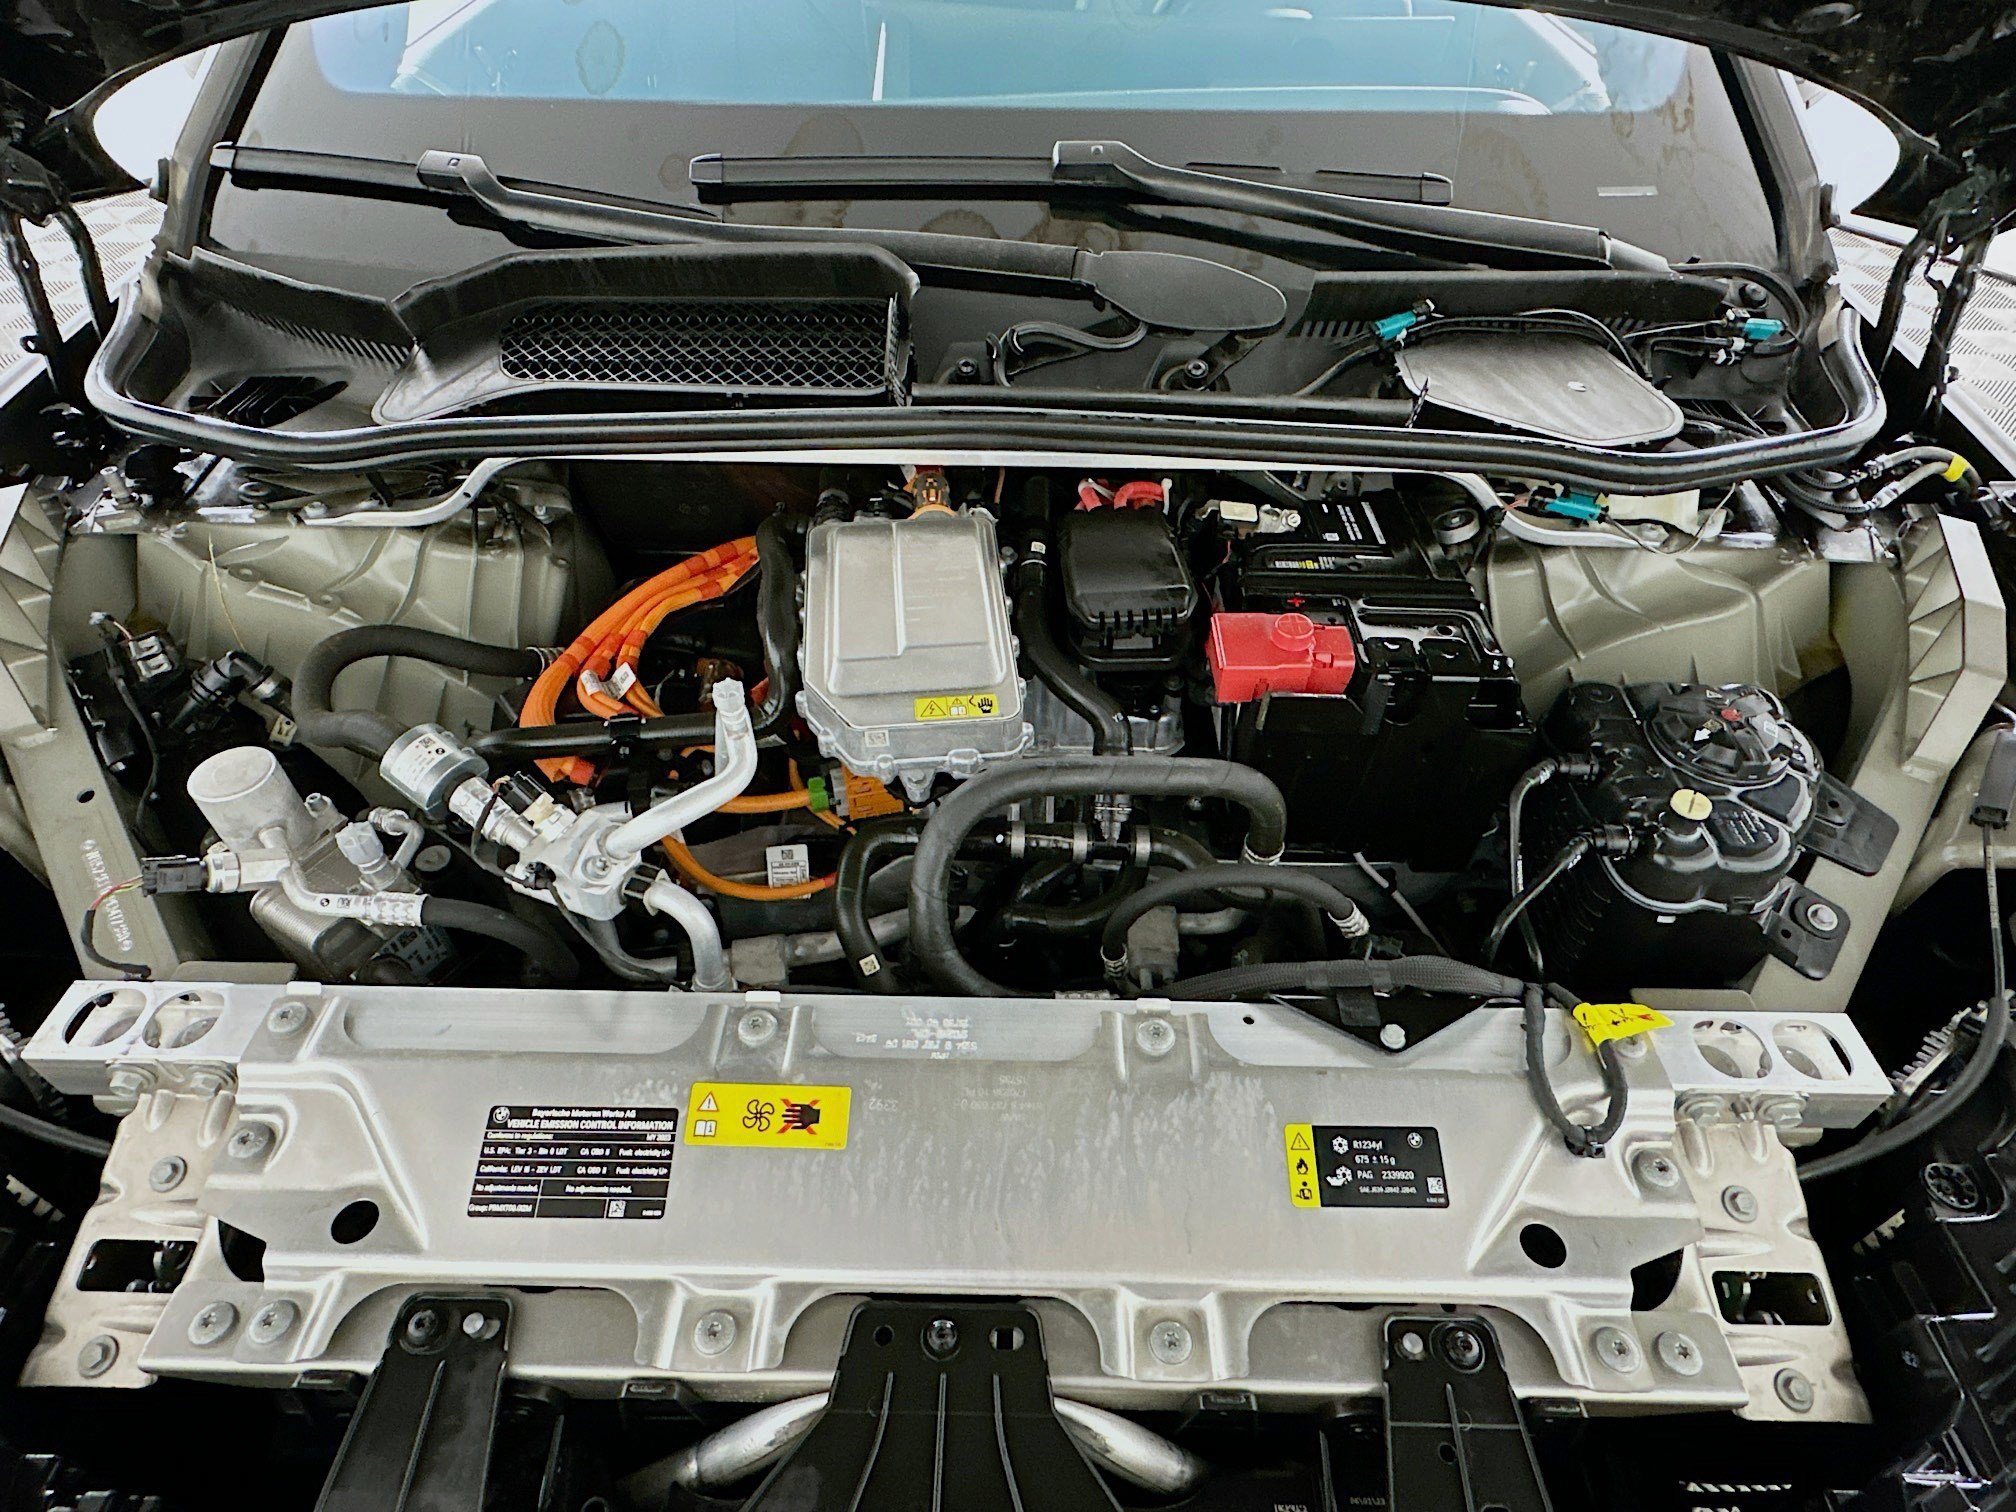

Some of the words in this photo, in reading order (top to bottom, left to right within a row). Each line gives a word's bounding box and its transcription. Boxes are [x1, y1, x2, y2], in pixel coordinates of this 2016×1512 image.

[602, 1109, 624, 1118] Werke
[625, 1110, 636, 1118] AG
[507, 1119, 540, 1129] VEHICLE
[540, 1119, 579, 1129] EMISSION
[580, 1120, 617, 1130] CONTROL
[618, 1120, 674, 1130] INFORMATION
[1352, 1140, 1382, 1151] R1234yf
[483, 1146, 495, 1154] U.S.
[515, 1147, 527, 1155] Tier
[526, 1147, 533, 1155] 3
[537, 1147, 549, 1155] Bin
[555, 1147, 569, 1155] LDT
[1354, 1154, 1370, 1164] 675
[1379, 1154, 1389, 1164] 15
[1390, 1156, 1396, 1166] g
[549, 1166, 563, 1174] LDT
[577, 1166, 586, 1174] CA
[587, 1166, 601, 1174] OBD
[1357, 1170, 1374, 1179] PAG
[1381, 1170, 1415, 1180] 2339920
